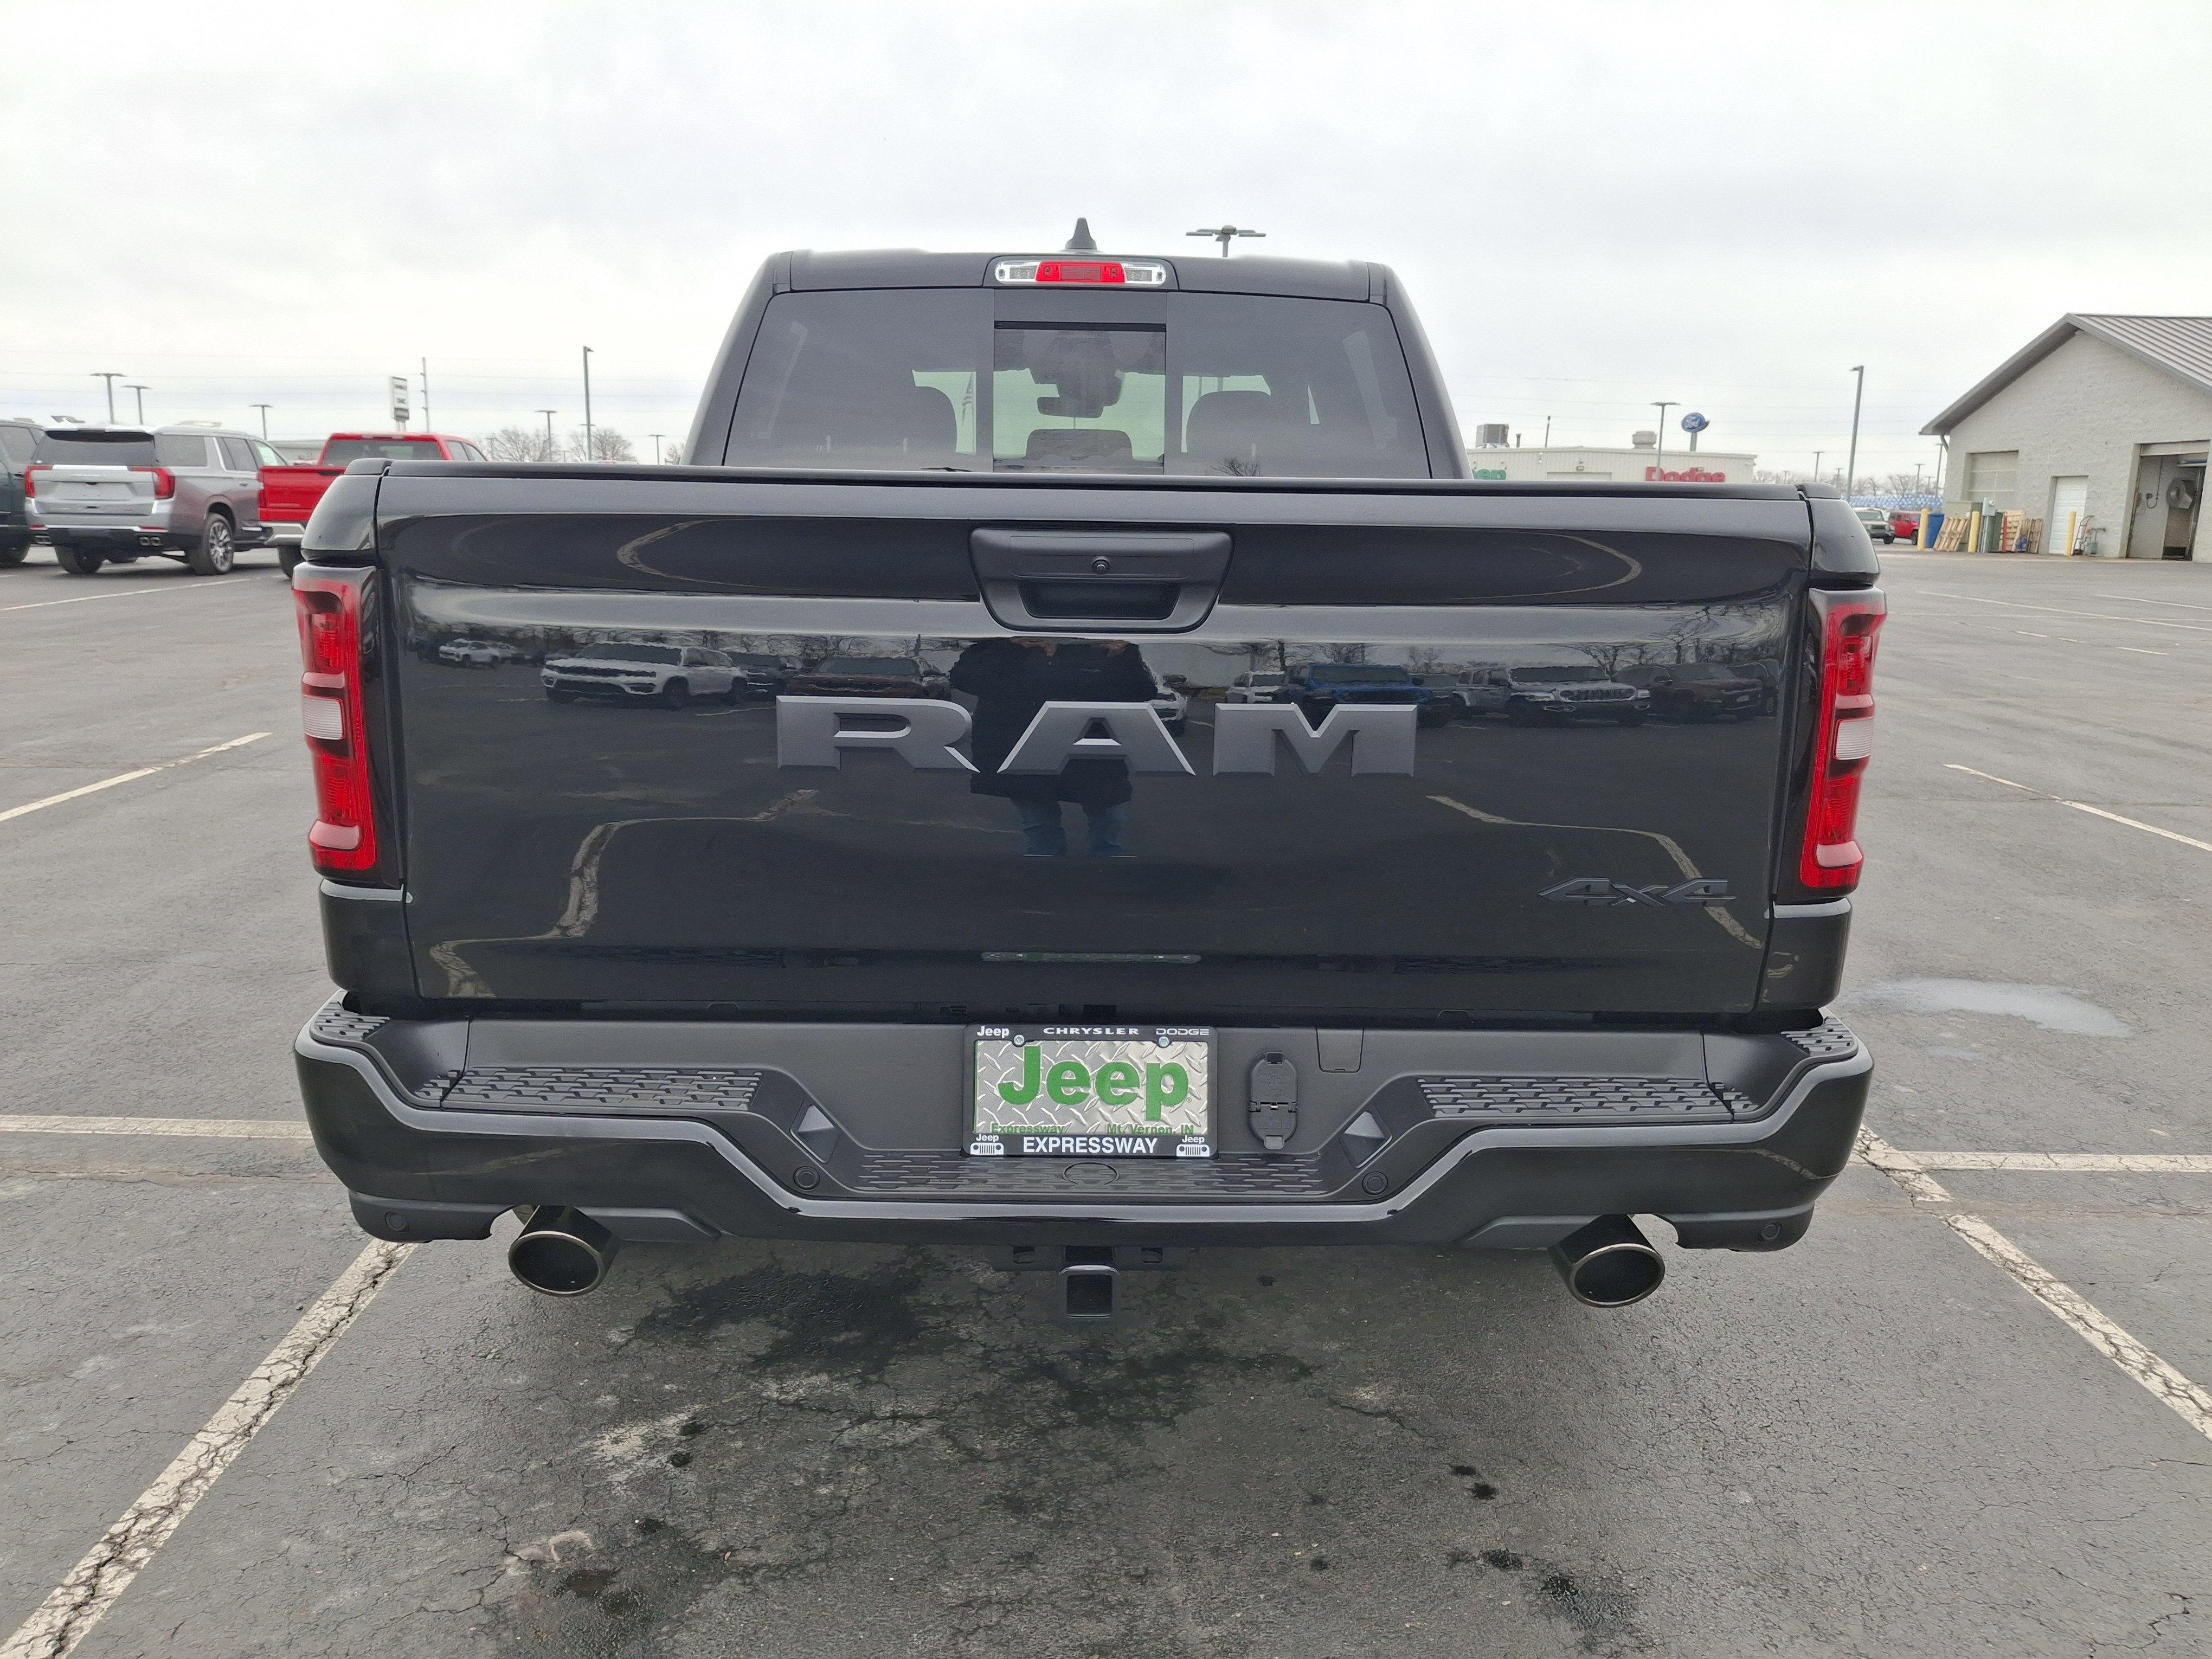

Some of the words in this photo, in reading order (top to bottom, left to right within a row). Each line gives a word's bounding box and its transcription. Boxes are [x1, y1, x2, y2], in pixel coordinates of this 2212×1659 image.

[776, 696, 1418, 777] RAM
[976, 1025, 1009, 1038] Jeep
[998, 1045, 1189, 1122] Jeep
[991, 1123, 1064, 1134] Expressway
[1107, 1123, 1125, 1134] Mt.
[1180, 1124, 1194, 1134] IN
[976, 1134, 999, 1142] Jeep
[1181, 1135, 1205, 1143] Jeep
[1023, 1136, 1158, 1154] EXPRESSWAY
